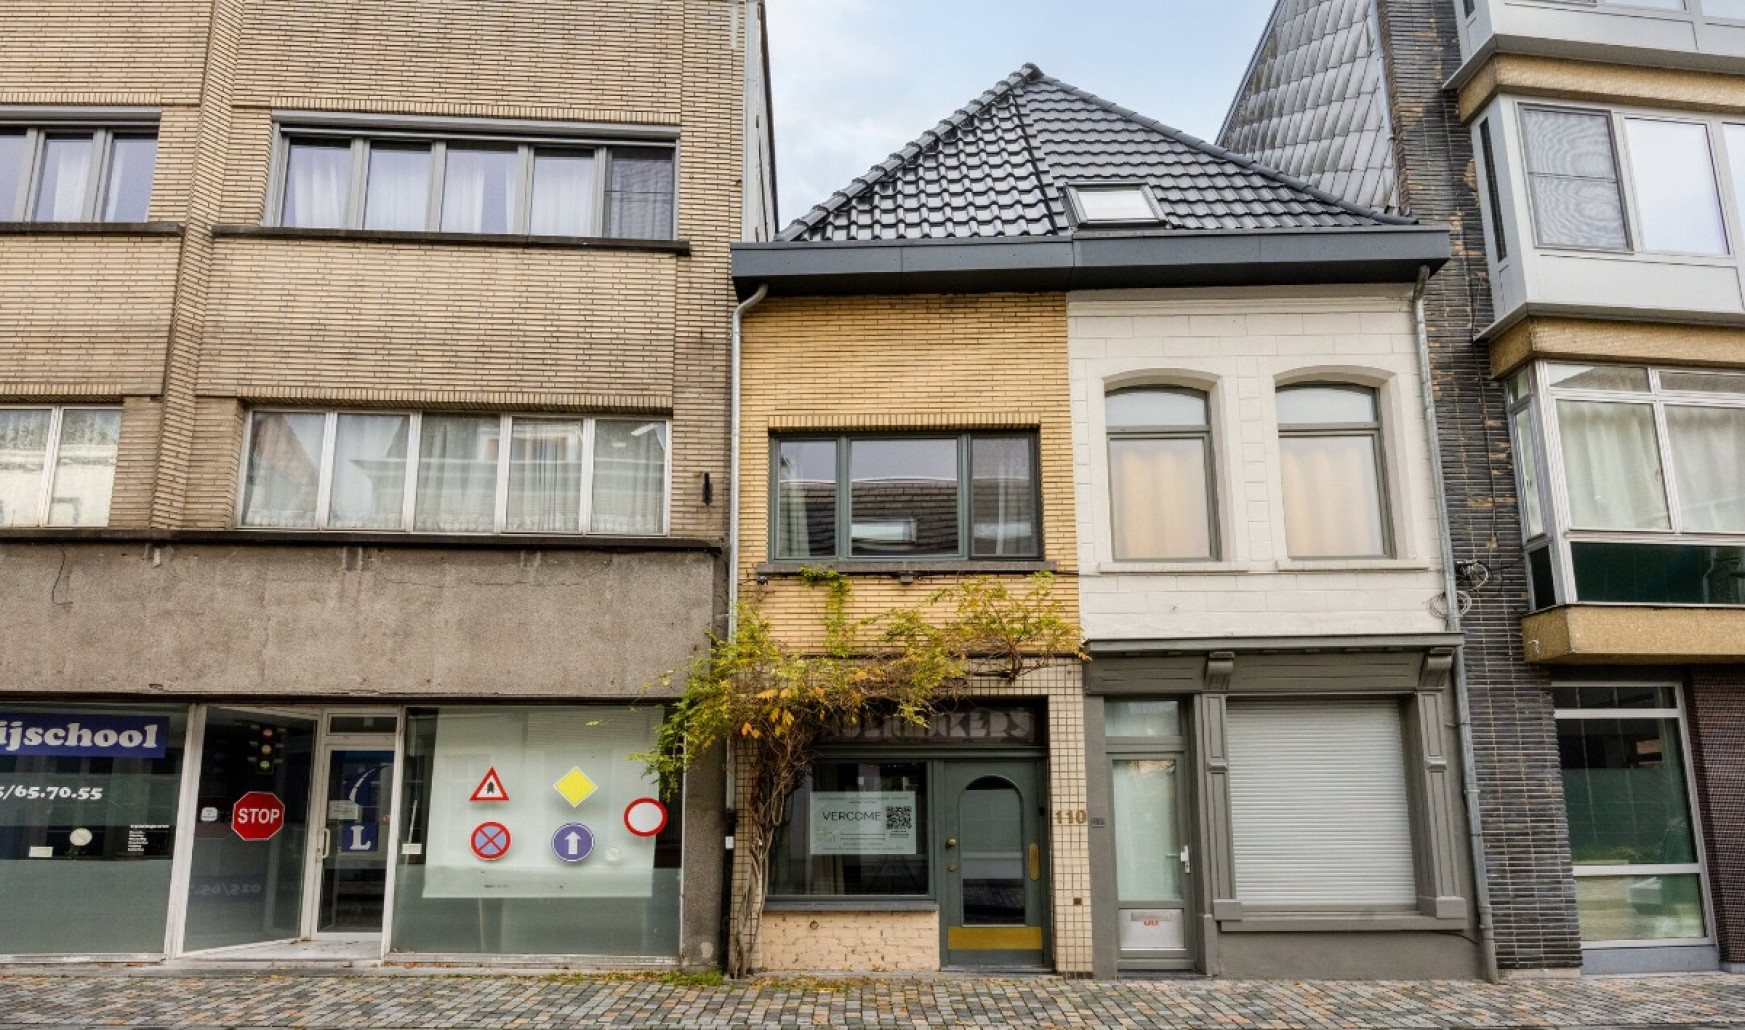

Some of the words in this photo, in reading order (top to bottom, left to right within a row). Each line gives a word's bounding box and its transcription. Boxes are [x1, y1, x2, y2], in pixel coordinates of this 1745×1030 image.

[237, 808, 280, 824] STOP
[1055, 809, 1087, 824] 110
[349, 825, 372, 850] L
